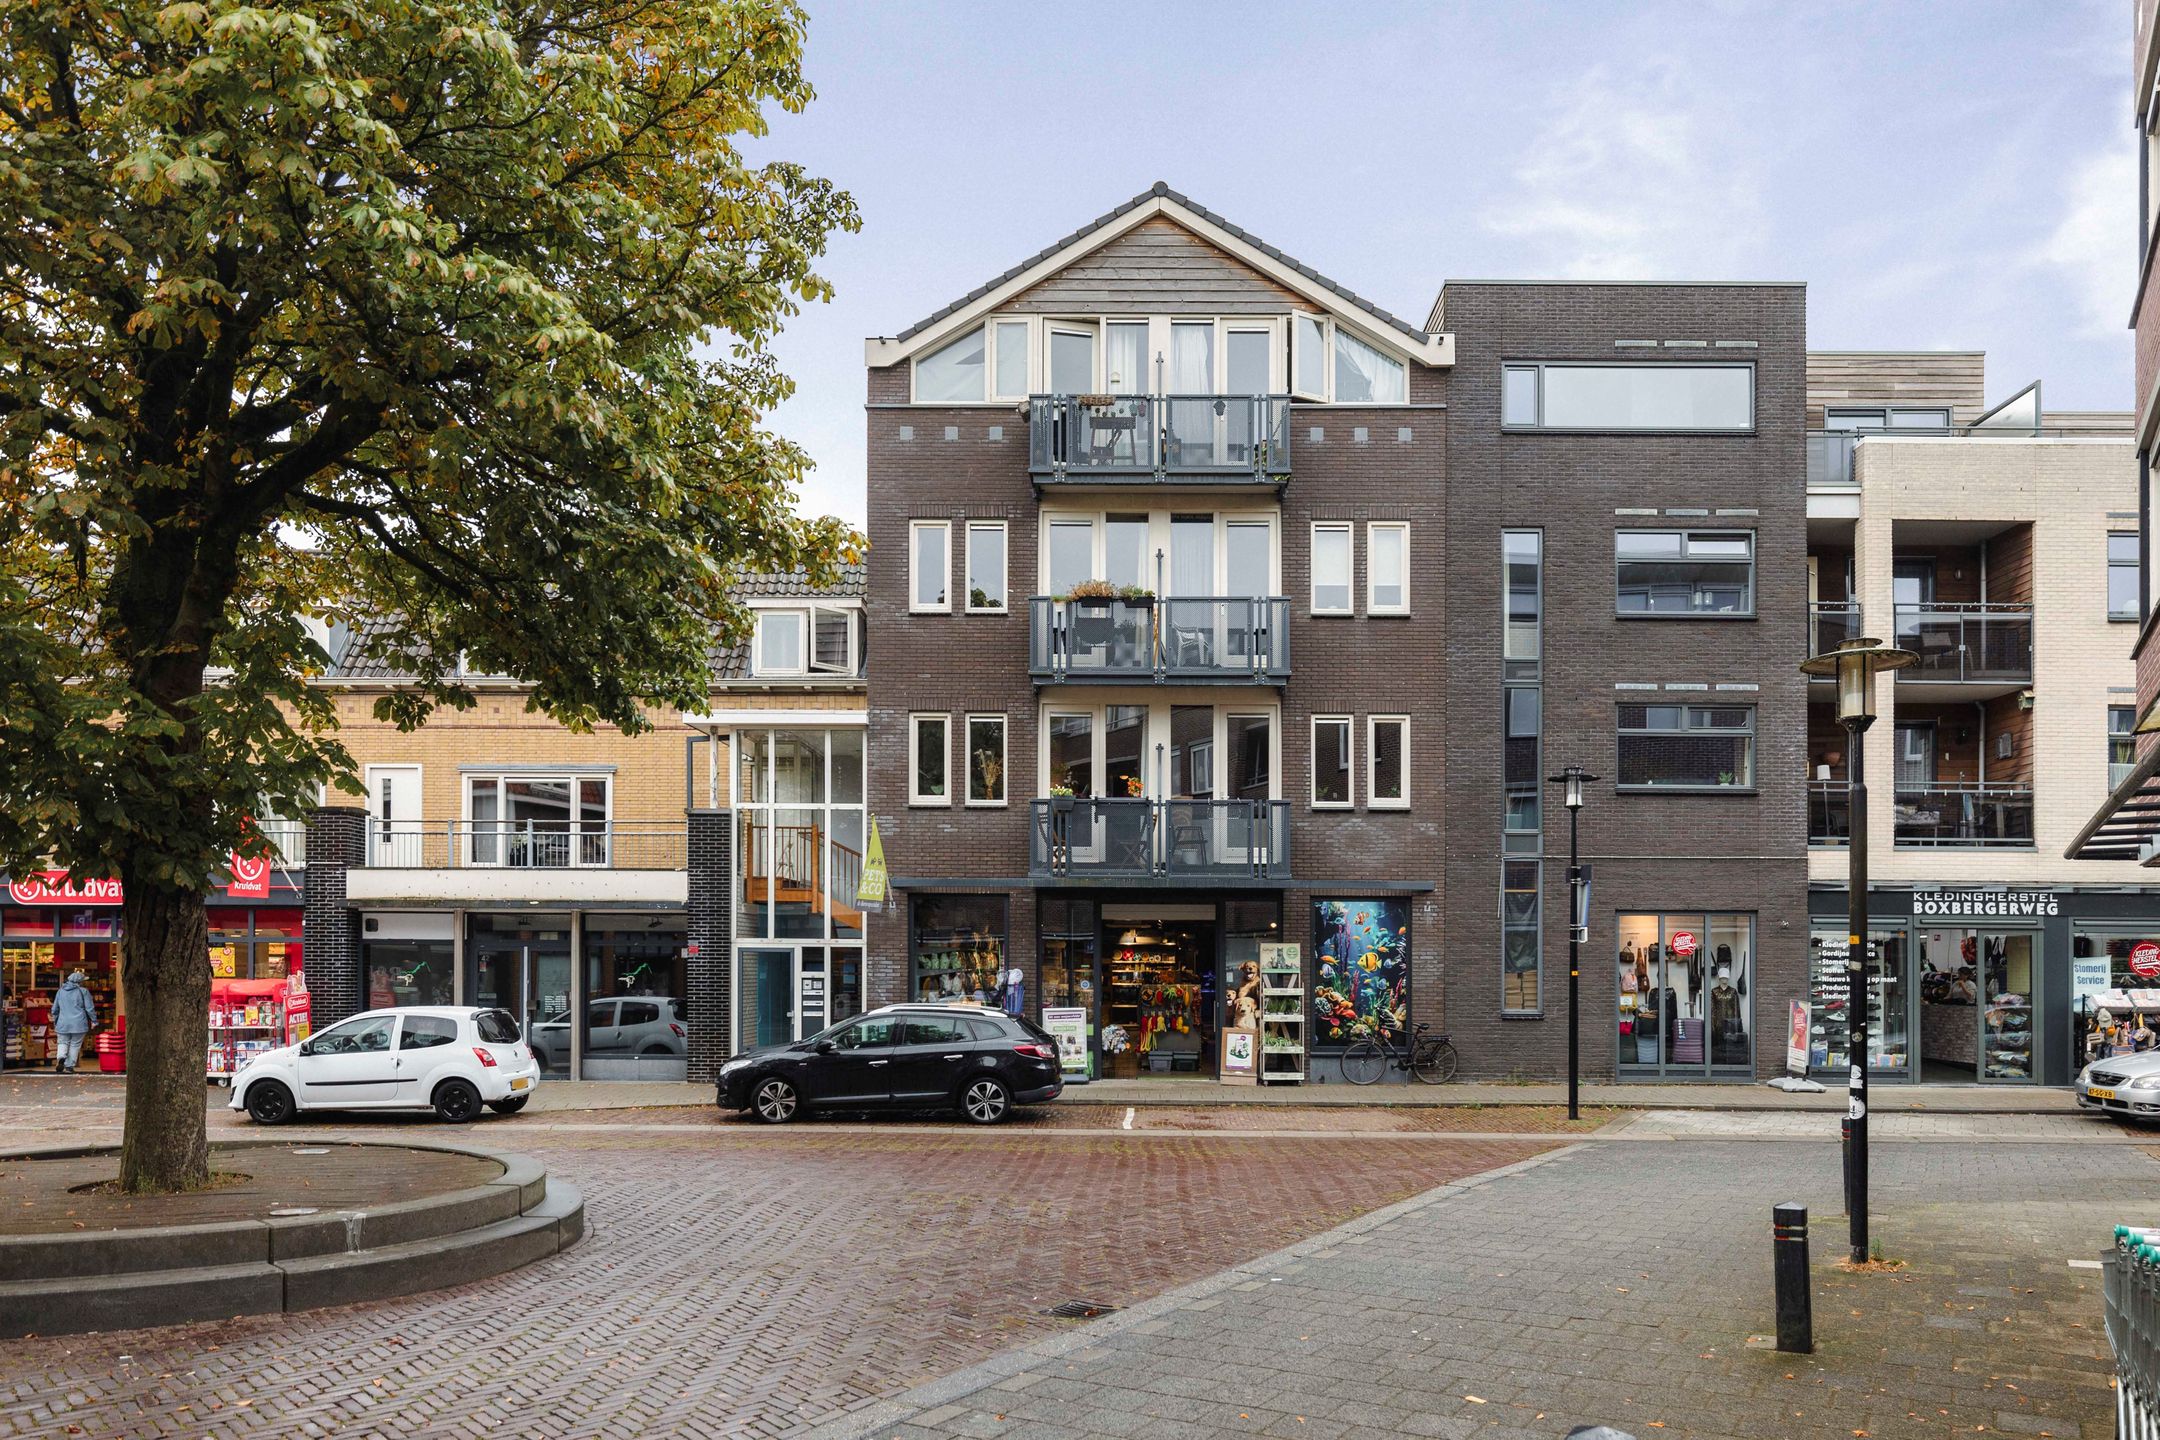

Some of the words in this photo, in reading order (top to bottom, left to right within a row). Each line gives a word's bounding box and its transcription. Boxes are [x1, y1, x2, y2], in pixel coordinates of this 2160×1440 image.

[234, 881, 262, 891] Kruidvat
[1913, 892, 2058, 902] KLEDINGHERSTEL
[1913, 902, 2058, 915] BOXBERGERWEG
[2074, 964, 2106, 973] Stomerij
[2077, 976, 2105, 985] Service
